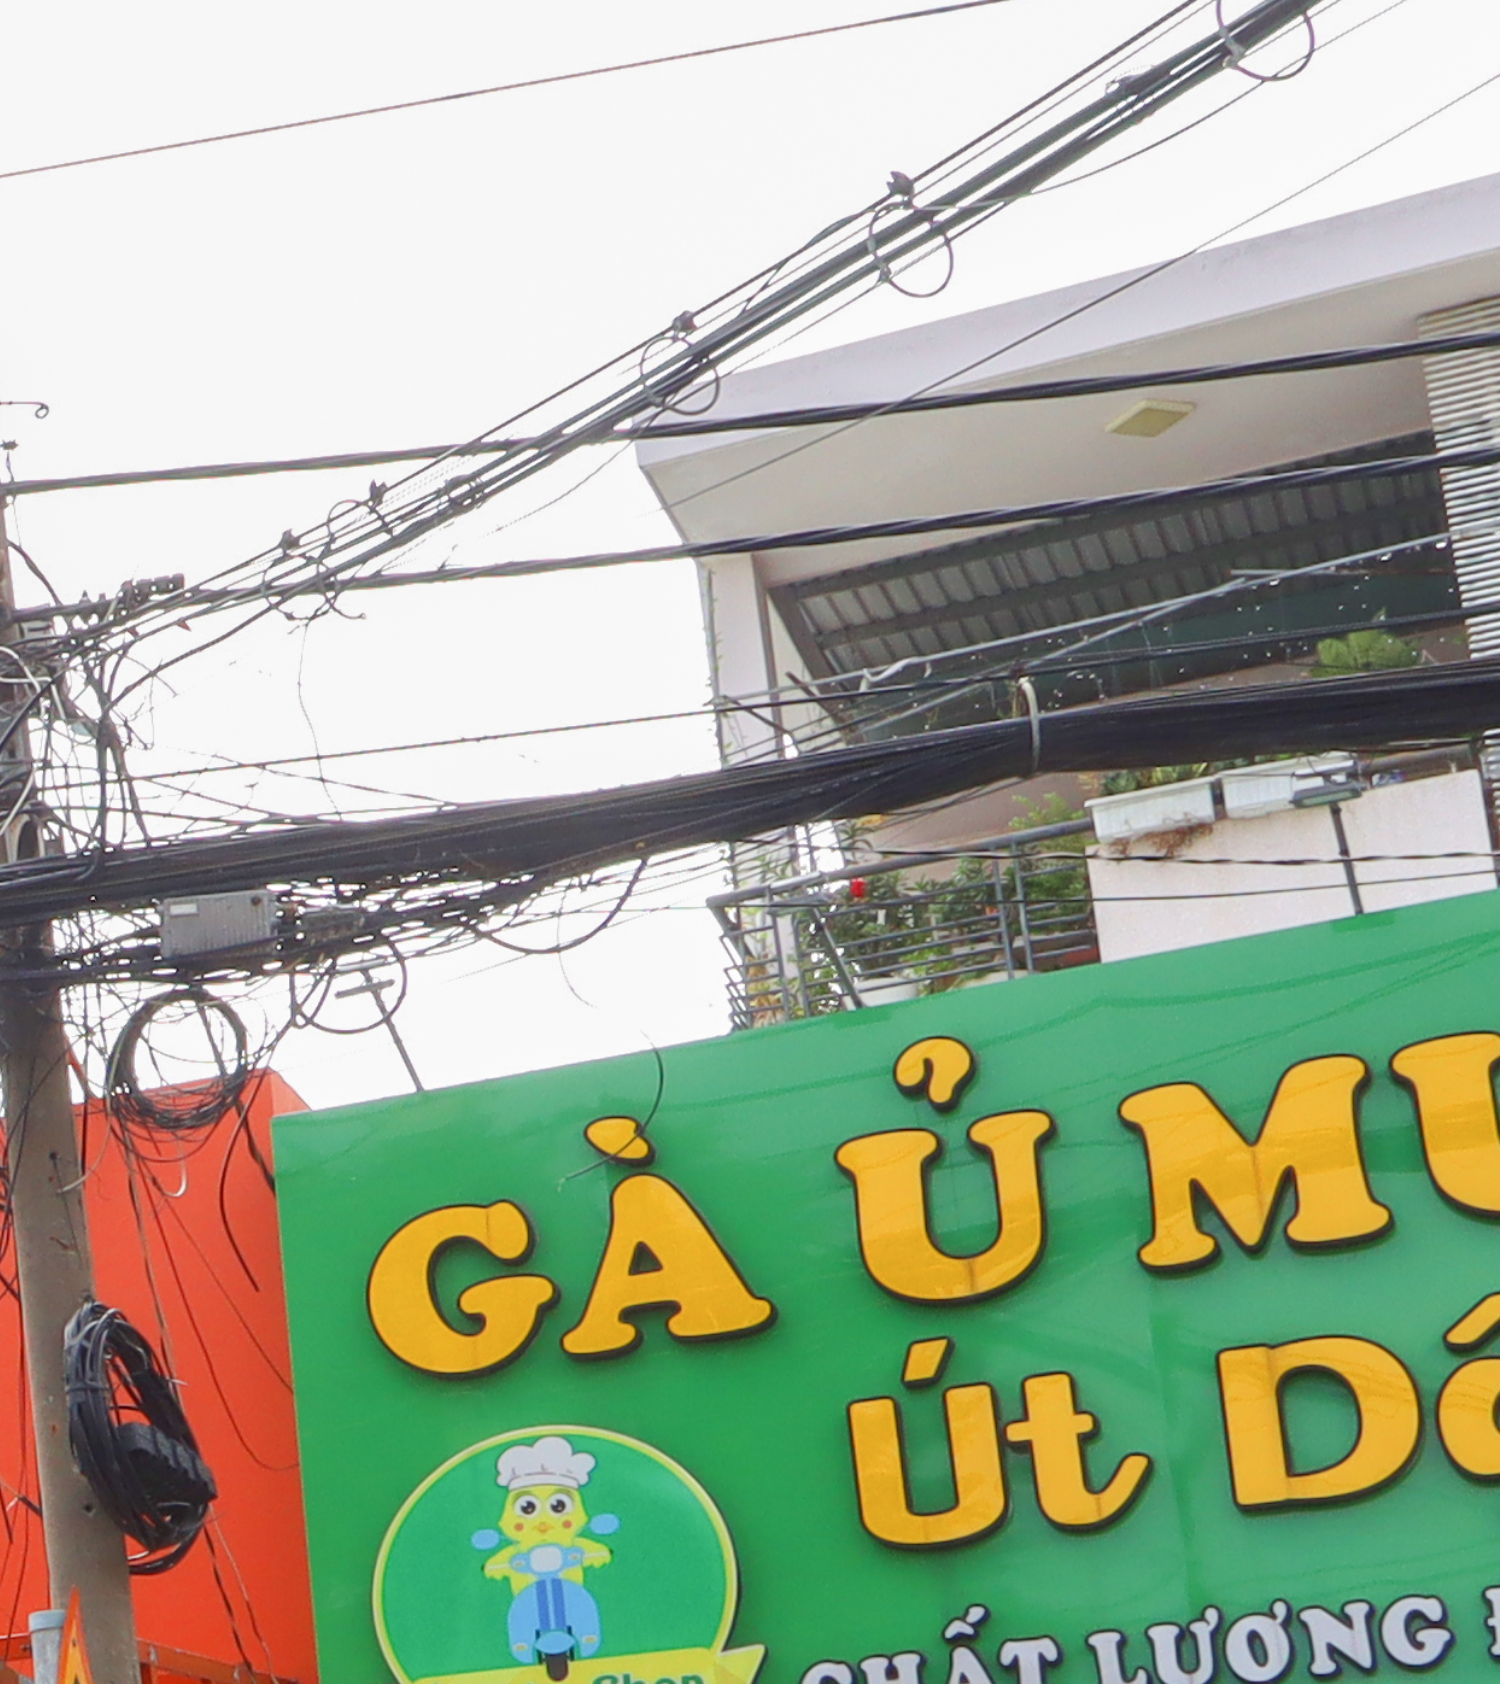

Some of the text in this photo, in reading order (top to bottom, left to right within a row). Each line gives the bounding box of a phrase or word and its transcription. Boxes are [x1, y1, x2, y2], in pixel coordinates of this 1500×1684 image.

[365, 1116, 777, 1378] GÀ
[834, 1036, 1061, 1306] Ủ
[846, 1337, 1150, 1551] Út
